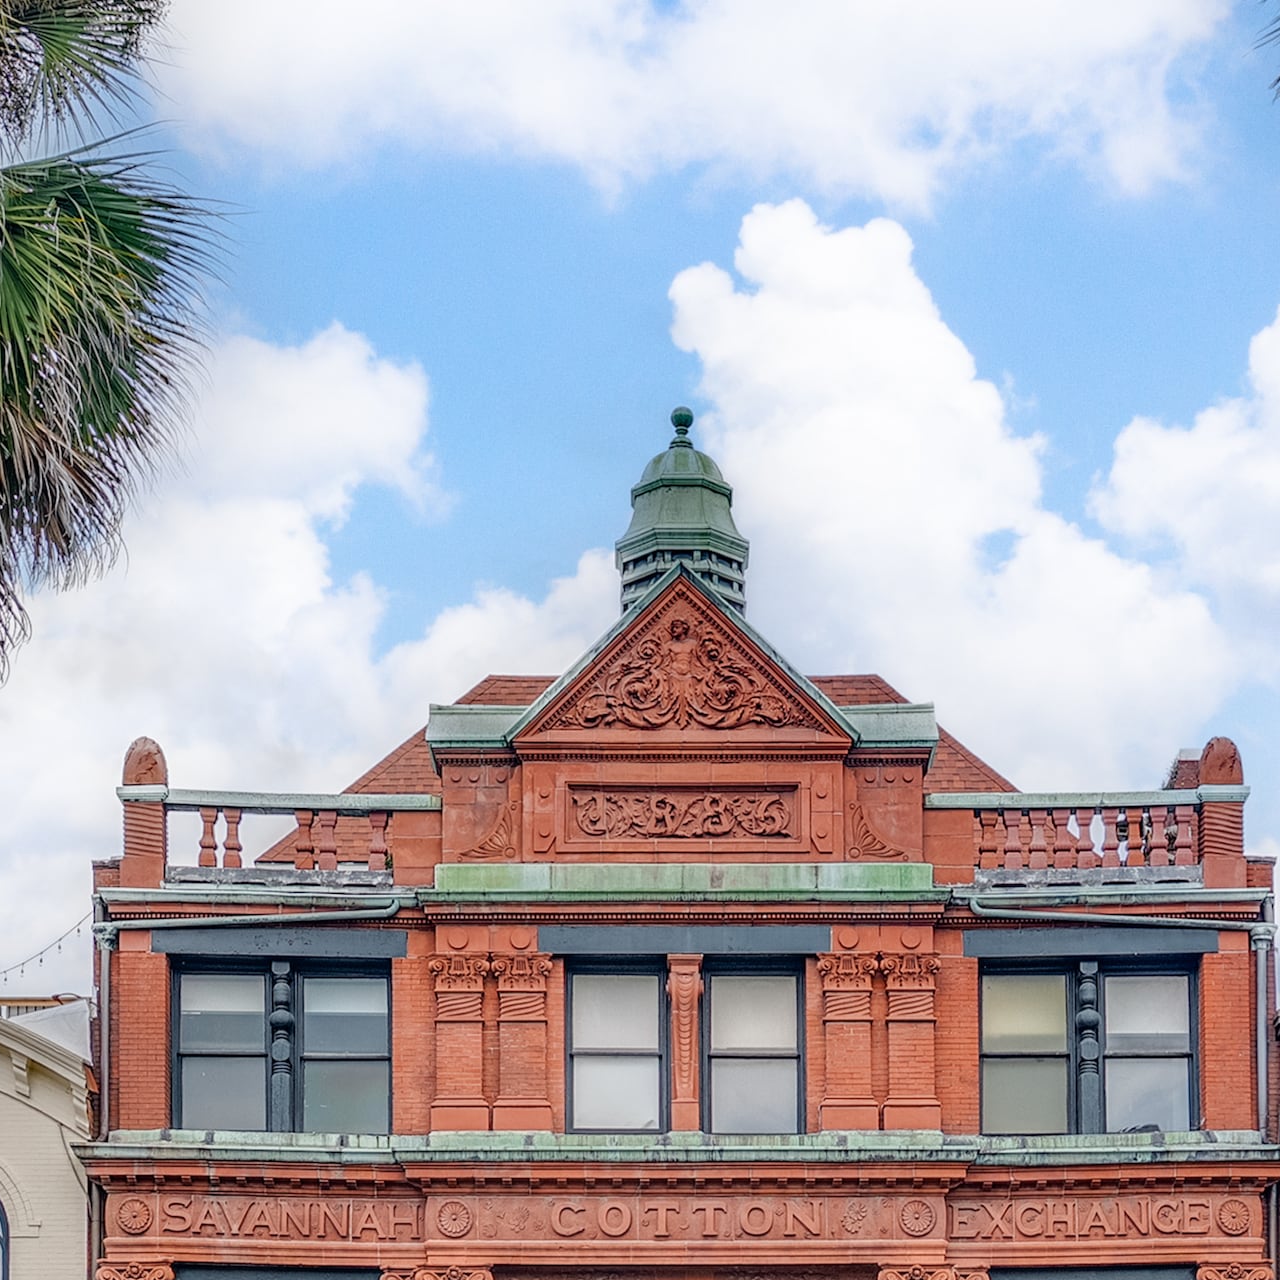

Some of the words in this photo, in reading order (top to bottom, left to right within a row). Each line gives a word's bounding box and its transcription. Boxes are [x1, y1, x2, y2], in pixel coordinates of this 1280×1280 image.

[162, 1200, 421, 1240] SAVANNAH
[550, 1200, 823, 1238] COTTON
[948, 1199, 1212, 1239] EXCHANGE
